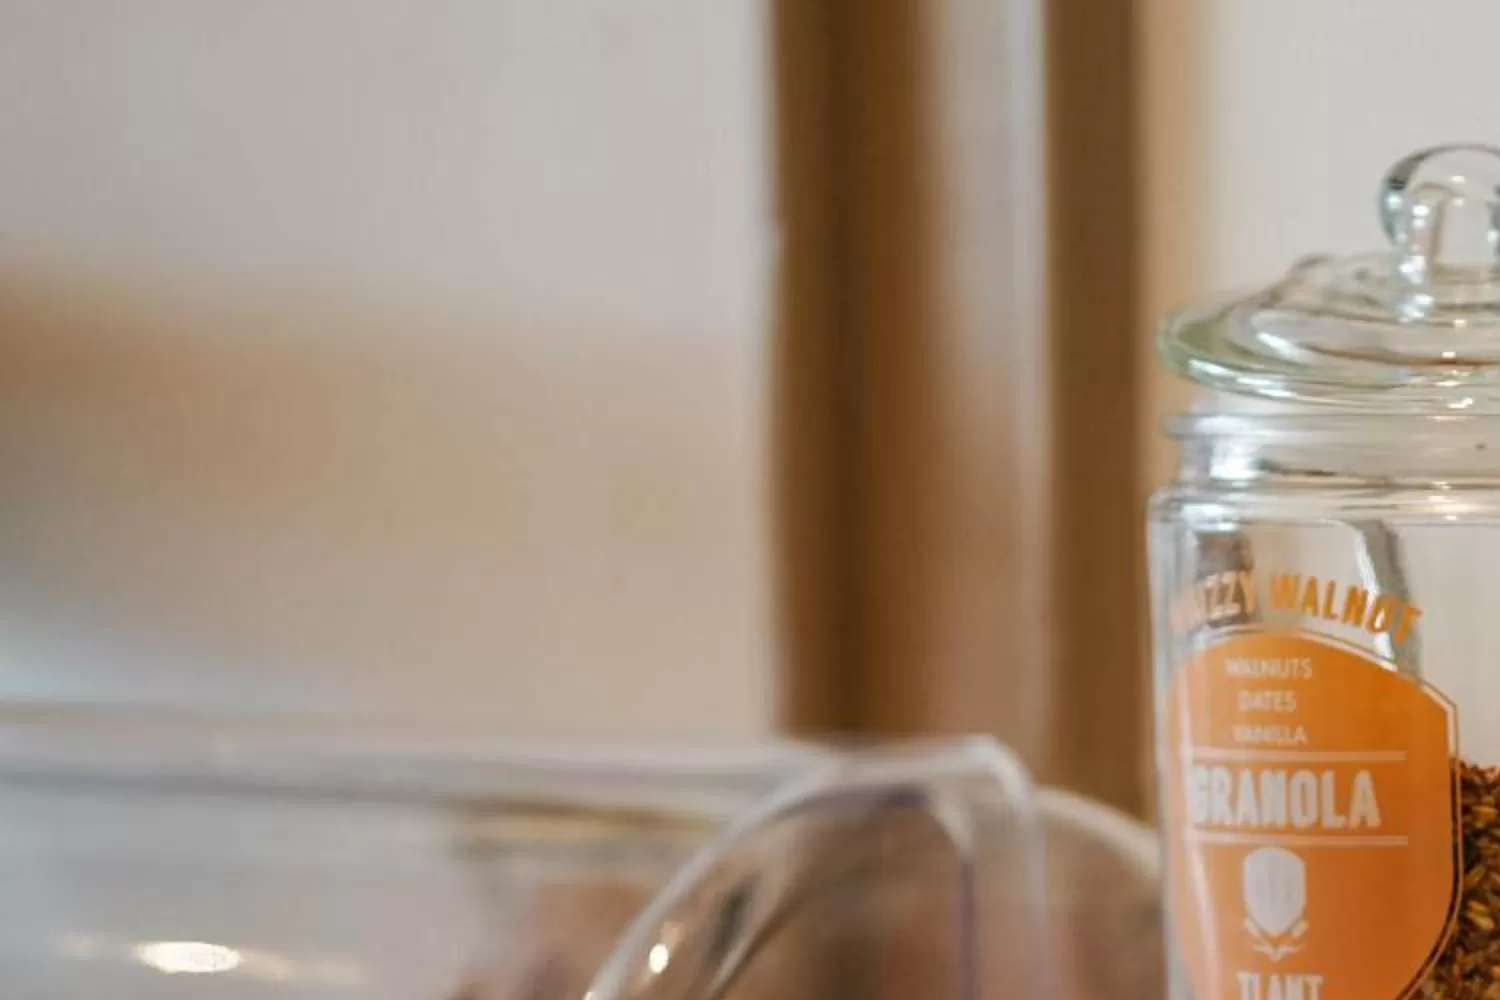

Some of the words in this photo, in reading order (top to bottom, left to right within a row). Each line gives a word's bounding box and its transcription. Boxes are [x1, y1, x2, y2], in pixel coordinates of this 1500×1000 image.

[1268, 574, 1422, 645] WALNUT
[1224, 657, 1313, 679] WALNUTS
[1238, 690, 1297, 712] DATES
[1231, 725, 1310, 745] VANILLA
[1190, 766, 1382, 828] GRANOLA
